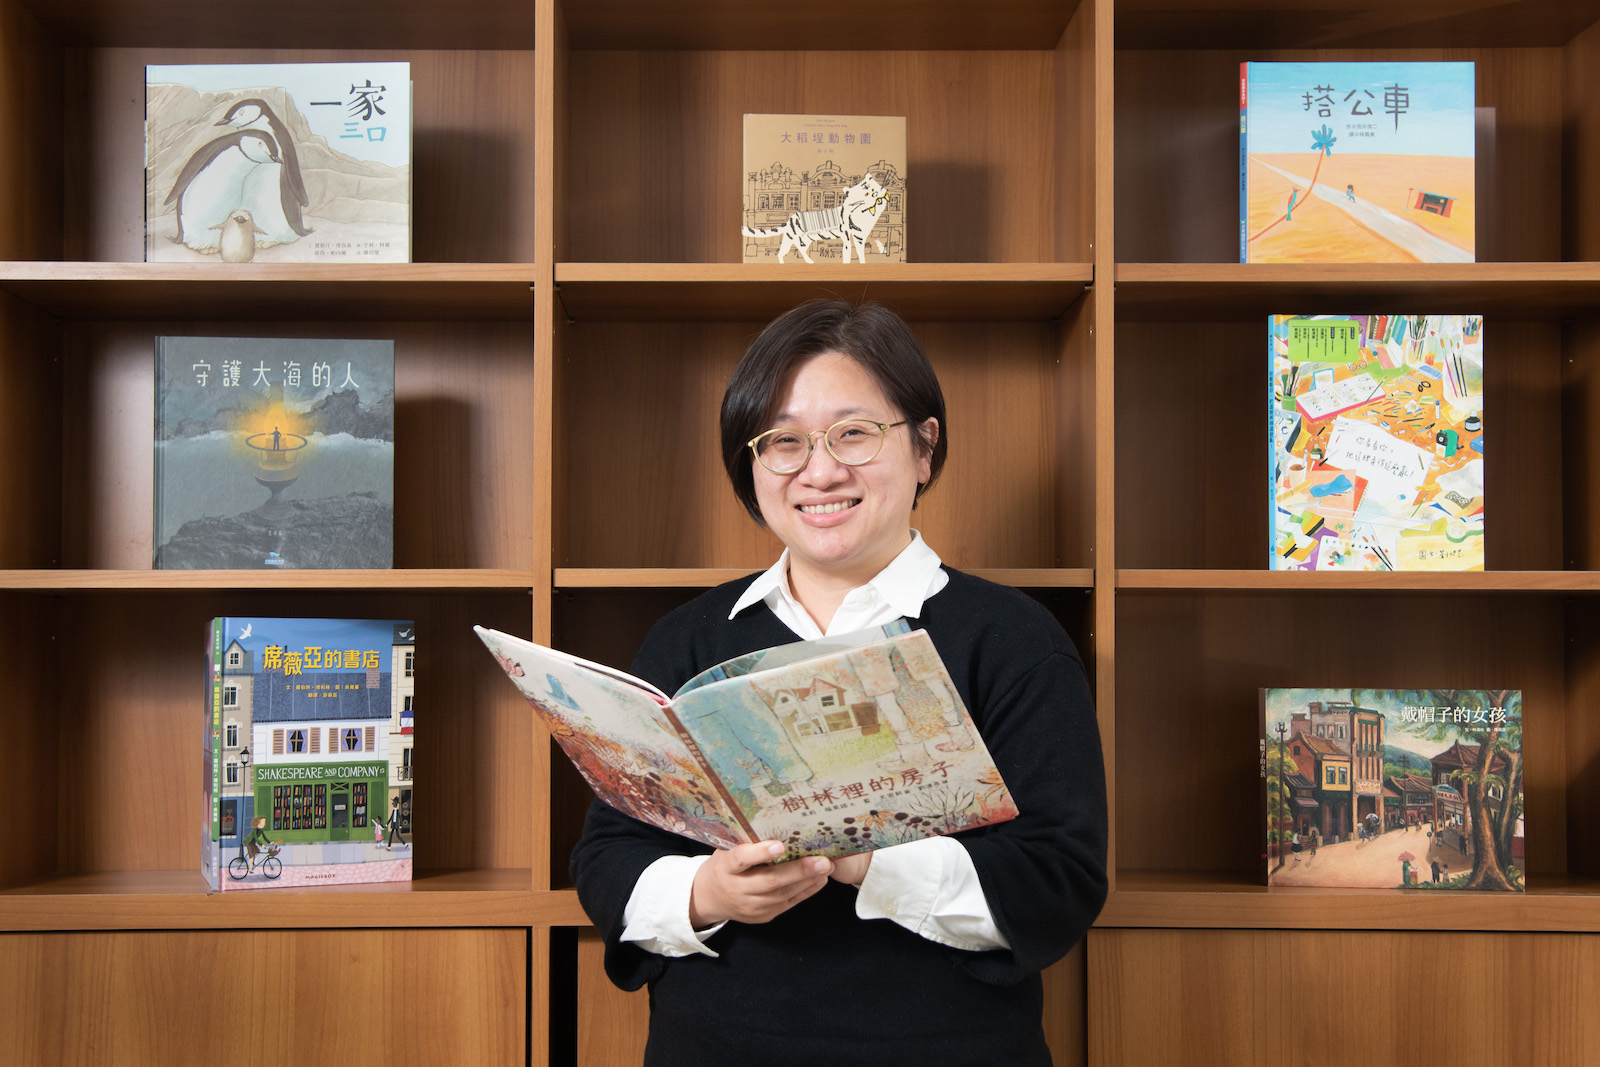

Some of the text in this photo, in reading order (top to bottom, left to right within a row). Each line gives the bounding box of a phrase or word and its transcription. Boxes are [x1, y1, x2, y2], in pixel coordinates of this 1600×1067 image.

[310, 79, 387, 121] 一家
[1301, 83, 1410, 134] 搭公車
[339, 122, 387, 142] 三口
[781, 131, 872, 145] 大稻埕動物園
[192, 359, 360, 389] 守護大海的人
[263, 644, 381, 676] 席薇亞的書店
[1400, 705, 1507, 724] 戴帽子的女孩
[257, 766, 324, 781] SHAKESPEARE
[324, 767, 338, 777] AND
[338, 766, 380, 778] COMPANY
[1259, 738, 1267, 778] 戴帽子的女孩
[781, 760, 954, 813] 樹林裡的房子
